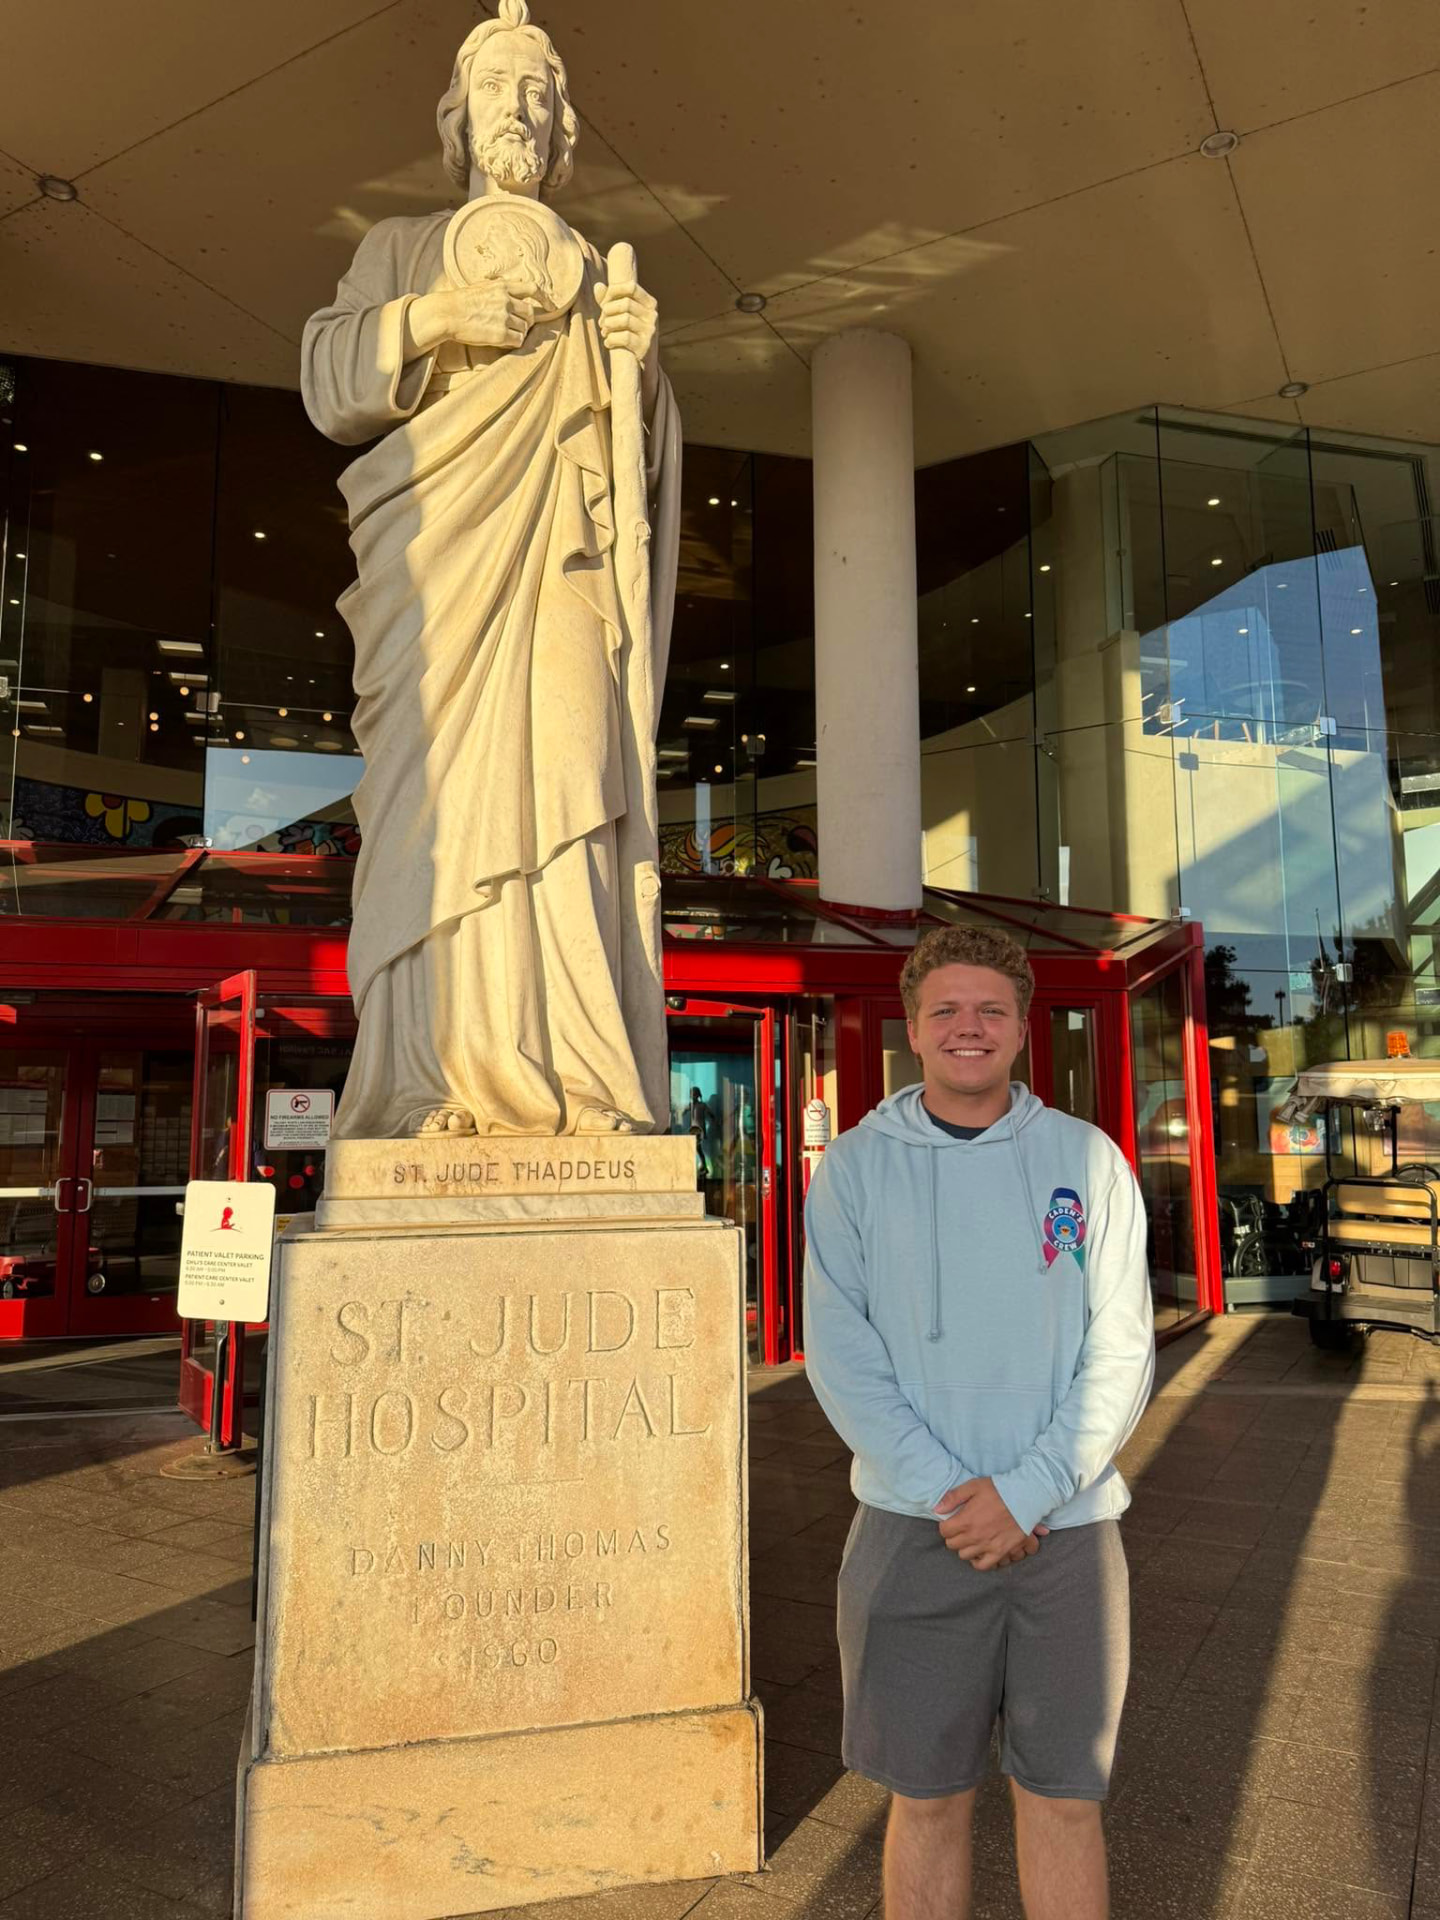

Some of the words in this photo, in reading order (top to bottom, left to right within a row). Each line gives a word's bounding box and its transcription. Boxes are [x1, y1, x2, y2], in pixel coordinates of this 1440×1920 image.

[394, 1164, 428, 1184] ST.
[436, 1162, 500, 1183] JUDE
[512, 1159, 636, 1182] THADDEUS
[1048, 1208, 1083, 1223] CADEN'S
[1053, 1240, 1077, 1251] CREW
[469, 1287, 695, 1358] JUDE
[307, 1374, 711, 1458] HOSPITAL
[352, 1537, 495, 1576] DANNY
